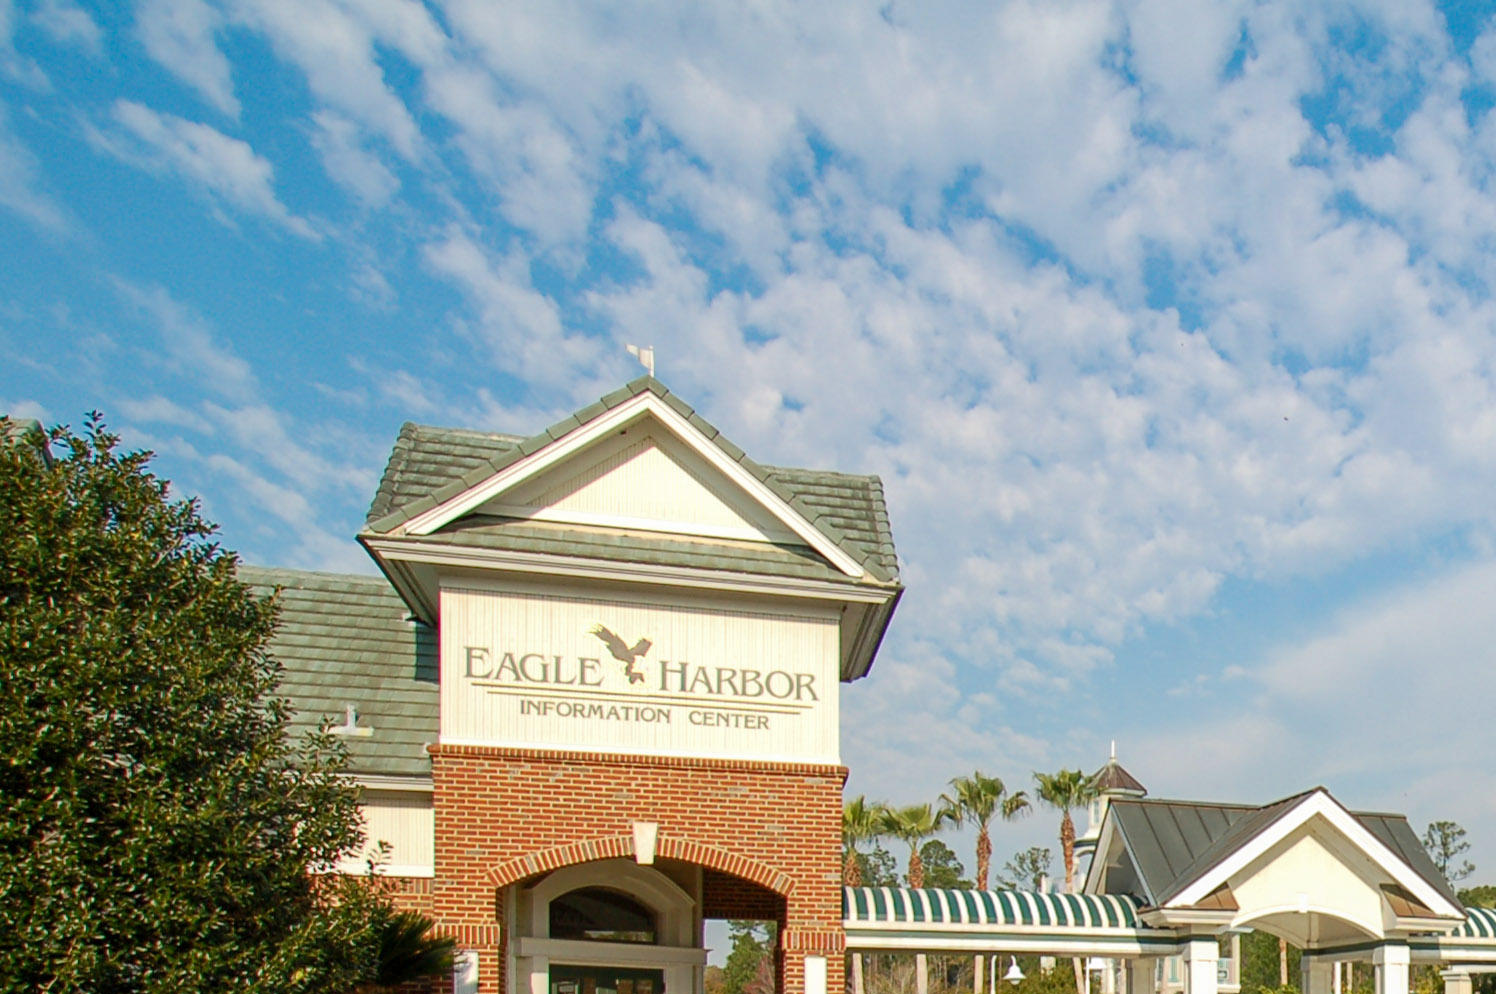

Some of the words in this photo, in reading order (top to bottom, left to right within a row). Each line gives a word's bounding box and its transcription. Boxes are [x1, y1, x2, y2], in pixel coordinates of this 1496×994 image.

[463, 645, 604, 686] EAGLE
[659, 661, 819, 701] HARBOR
[520, 700, 671, 724] INFORMATION
[688, 711, 770, 730] CENTER
